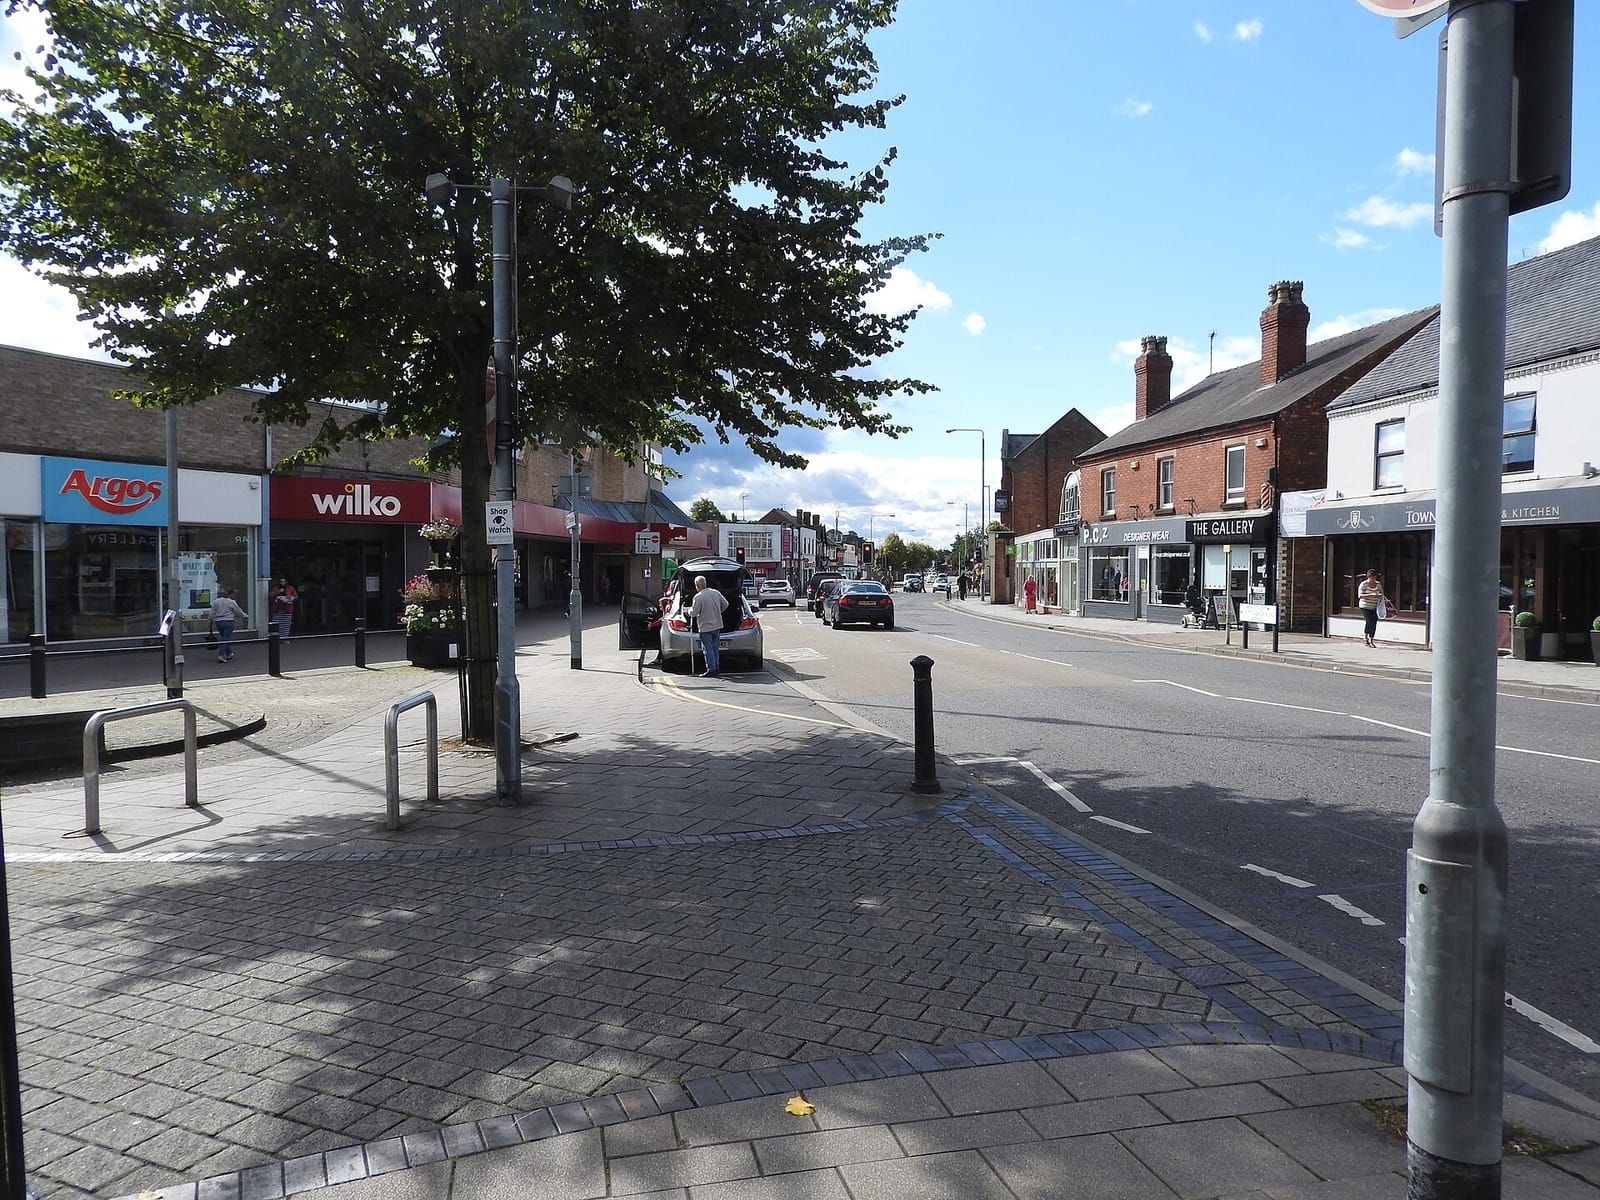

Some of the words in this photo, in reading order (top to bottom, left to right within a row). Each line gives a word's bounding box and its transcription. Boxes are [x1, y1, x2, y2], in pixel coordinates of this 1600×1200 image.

[60, 468, 163, 514] Argos
[311, 483, 402, 517] wilko
[489, 507, 508, 516] Shop
[1501, 509, 1508, 519] &
[1512, 505, 1560, 518] KITCHEN
[488, 526, 511, 535] Watch
[1192, 522, 1208, 536] THE
[1211, 519, 1255, 535] GALLERY
[1123, 532, 1150, 543] DESIGNER
[1151, 530, 1170, 541] WEAR
